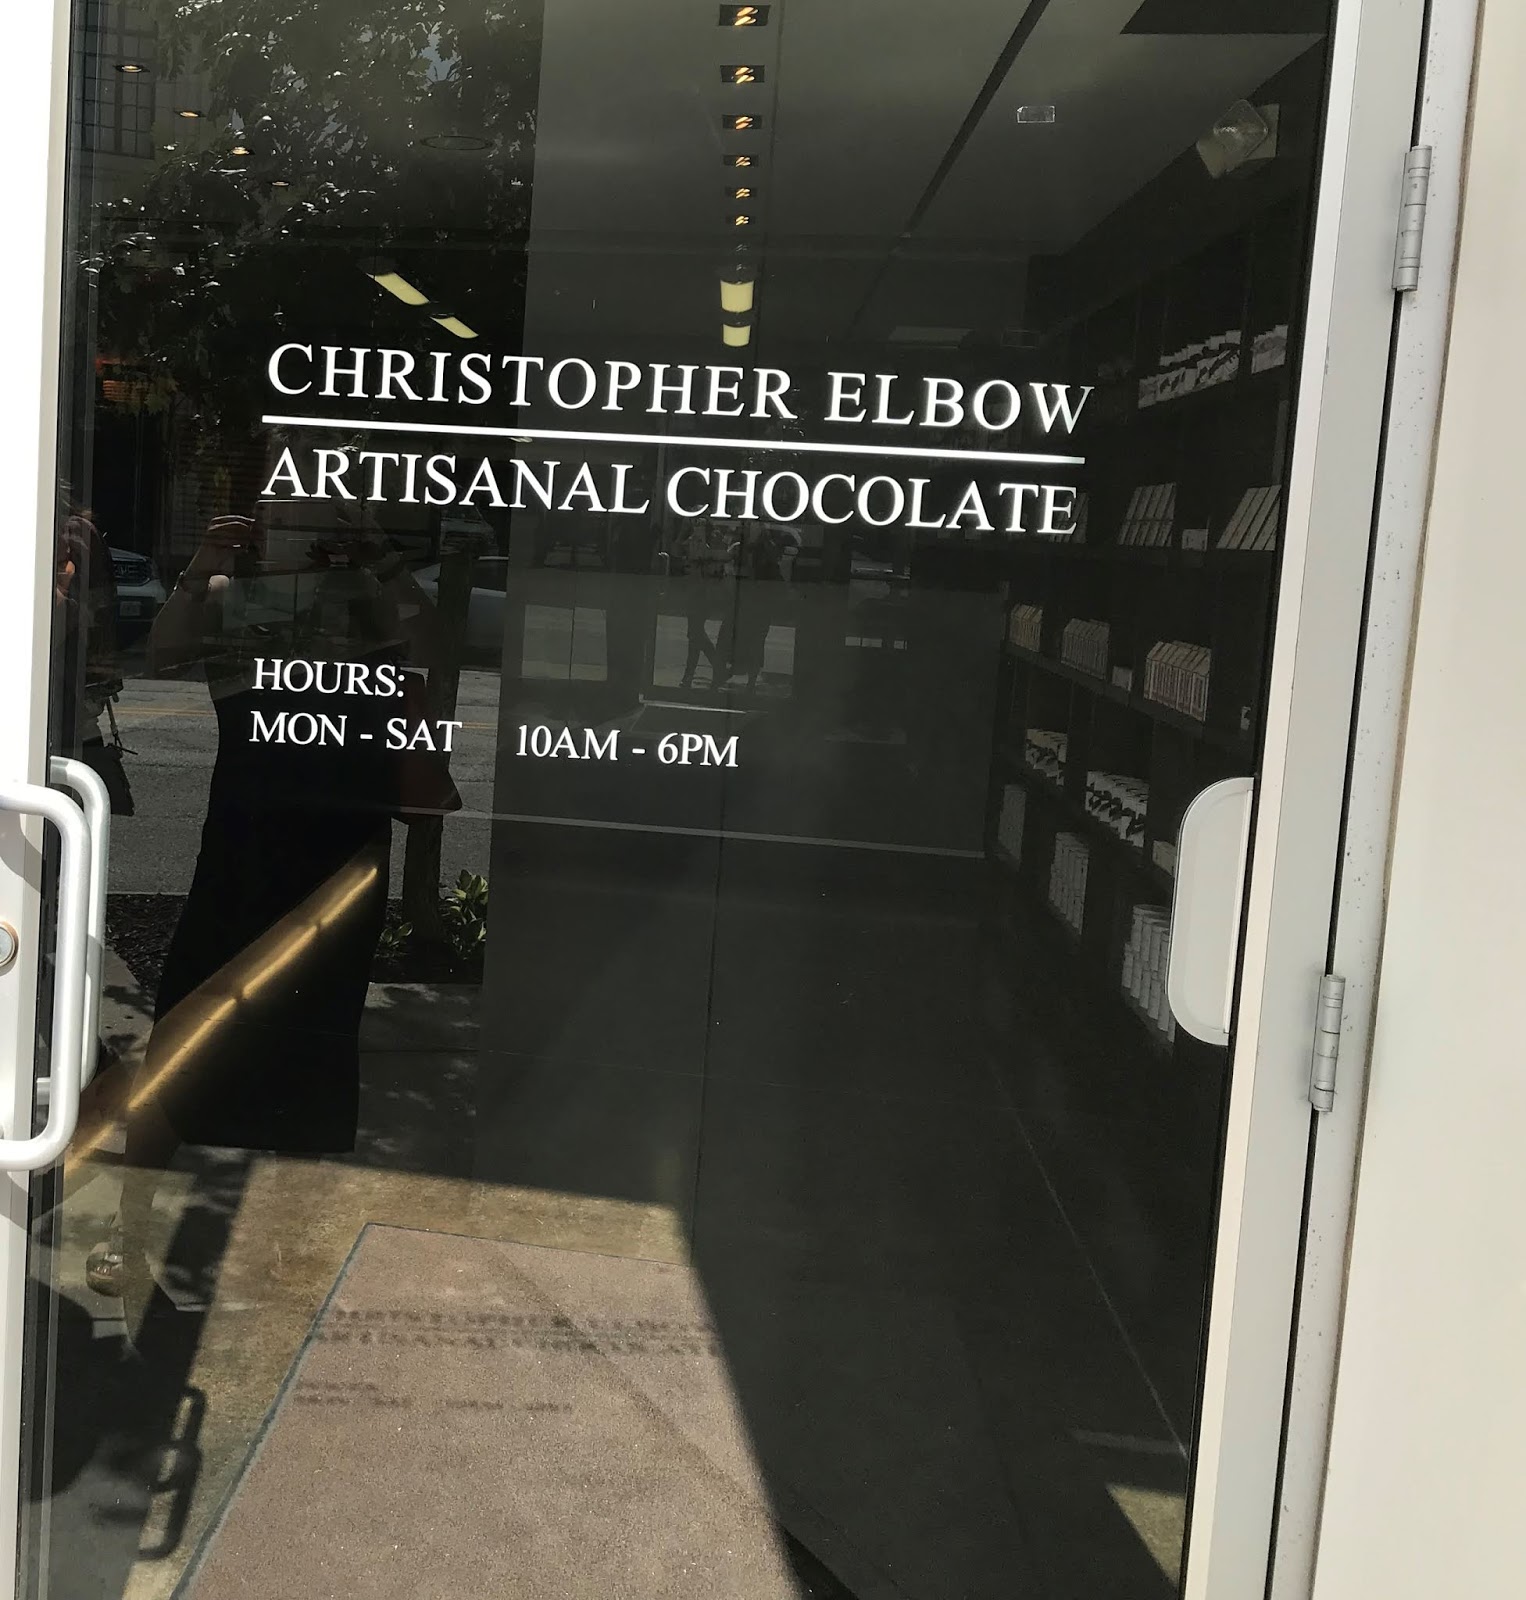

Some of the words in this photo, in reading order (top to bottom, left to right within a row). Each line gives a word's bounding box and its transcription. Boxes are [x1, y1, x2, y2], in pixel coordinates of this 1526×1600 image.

[268, 343, 797, 419] CHRISTOPHER
[824, 371, 1094, 434] ELBOW
[261, 446, 650, 514] ARTISANAL
[666, 466, 1077, 535] CHOCOLATE
[251, 657, 406, 697] HOURS:
[249, 710, 348, 747] MON
[385, 717, 463, 753] SAT
[516, 723, 621, 762] 10AM
[657, 732, 740, 768] 6PM
